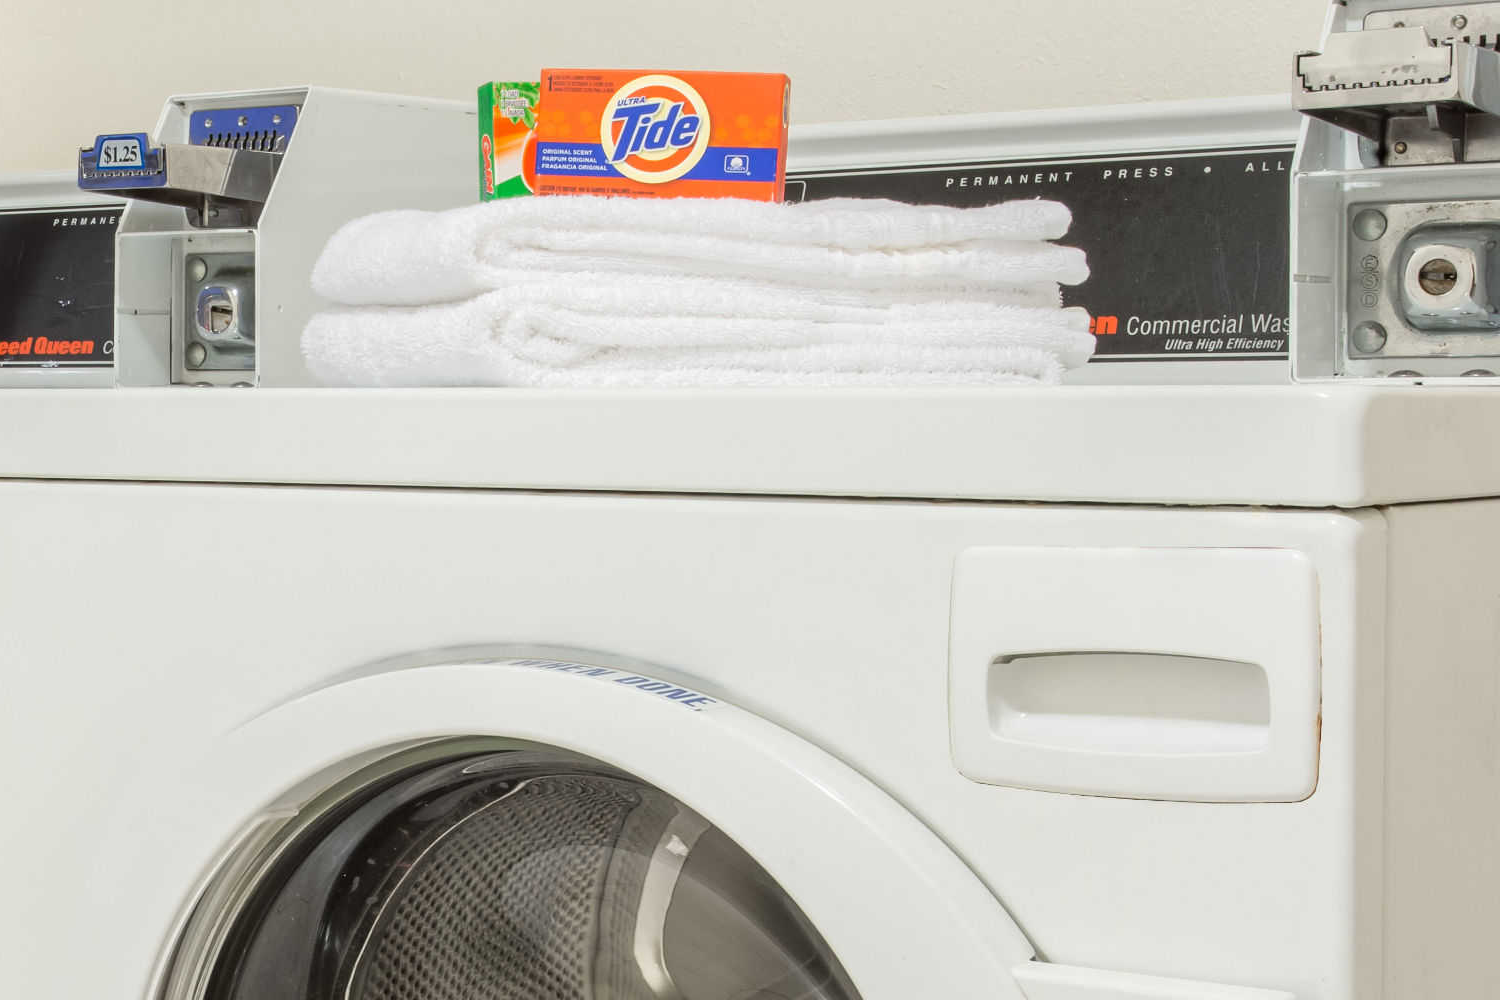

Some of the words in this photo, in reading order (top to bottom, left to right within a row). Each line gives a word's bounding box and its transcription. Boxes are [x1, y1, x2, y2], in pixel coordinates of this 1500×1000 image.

[617, 97, 646, 106] ULTRA
[612, 102, 700, 163] Tide
[104, 145, 138, 164] $1.25
[568, 156, 597, 164] ORIGINAL
[945, 172, 1073, 188] PERMANENT
[1103, 166, 1173, 180] PRESS
[1245, 161, 1285, 173] ALL
[53, 216, 120, 227] PERMANE
[1126, 314, 1244, 336] Commercial
[34, 336, 94, 355] Queen
[1164, 338, 1193, 351] Ultra
[1196, 338, 1224, 352] High
[1226, 336, 1285, 351] Efficiency
